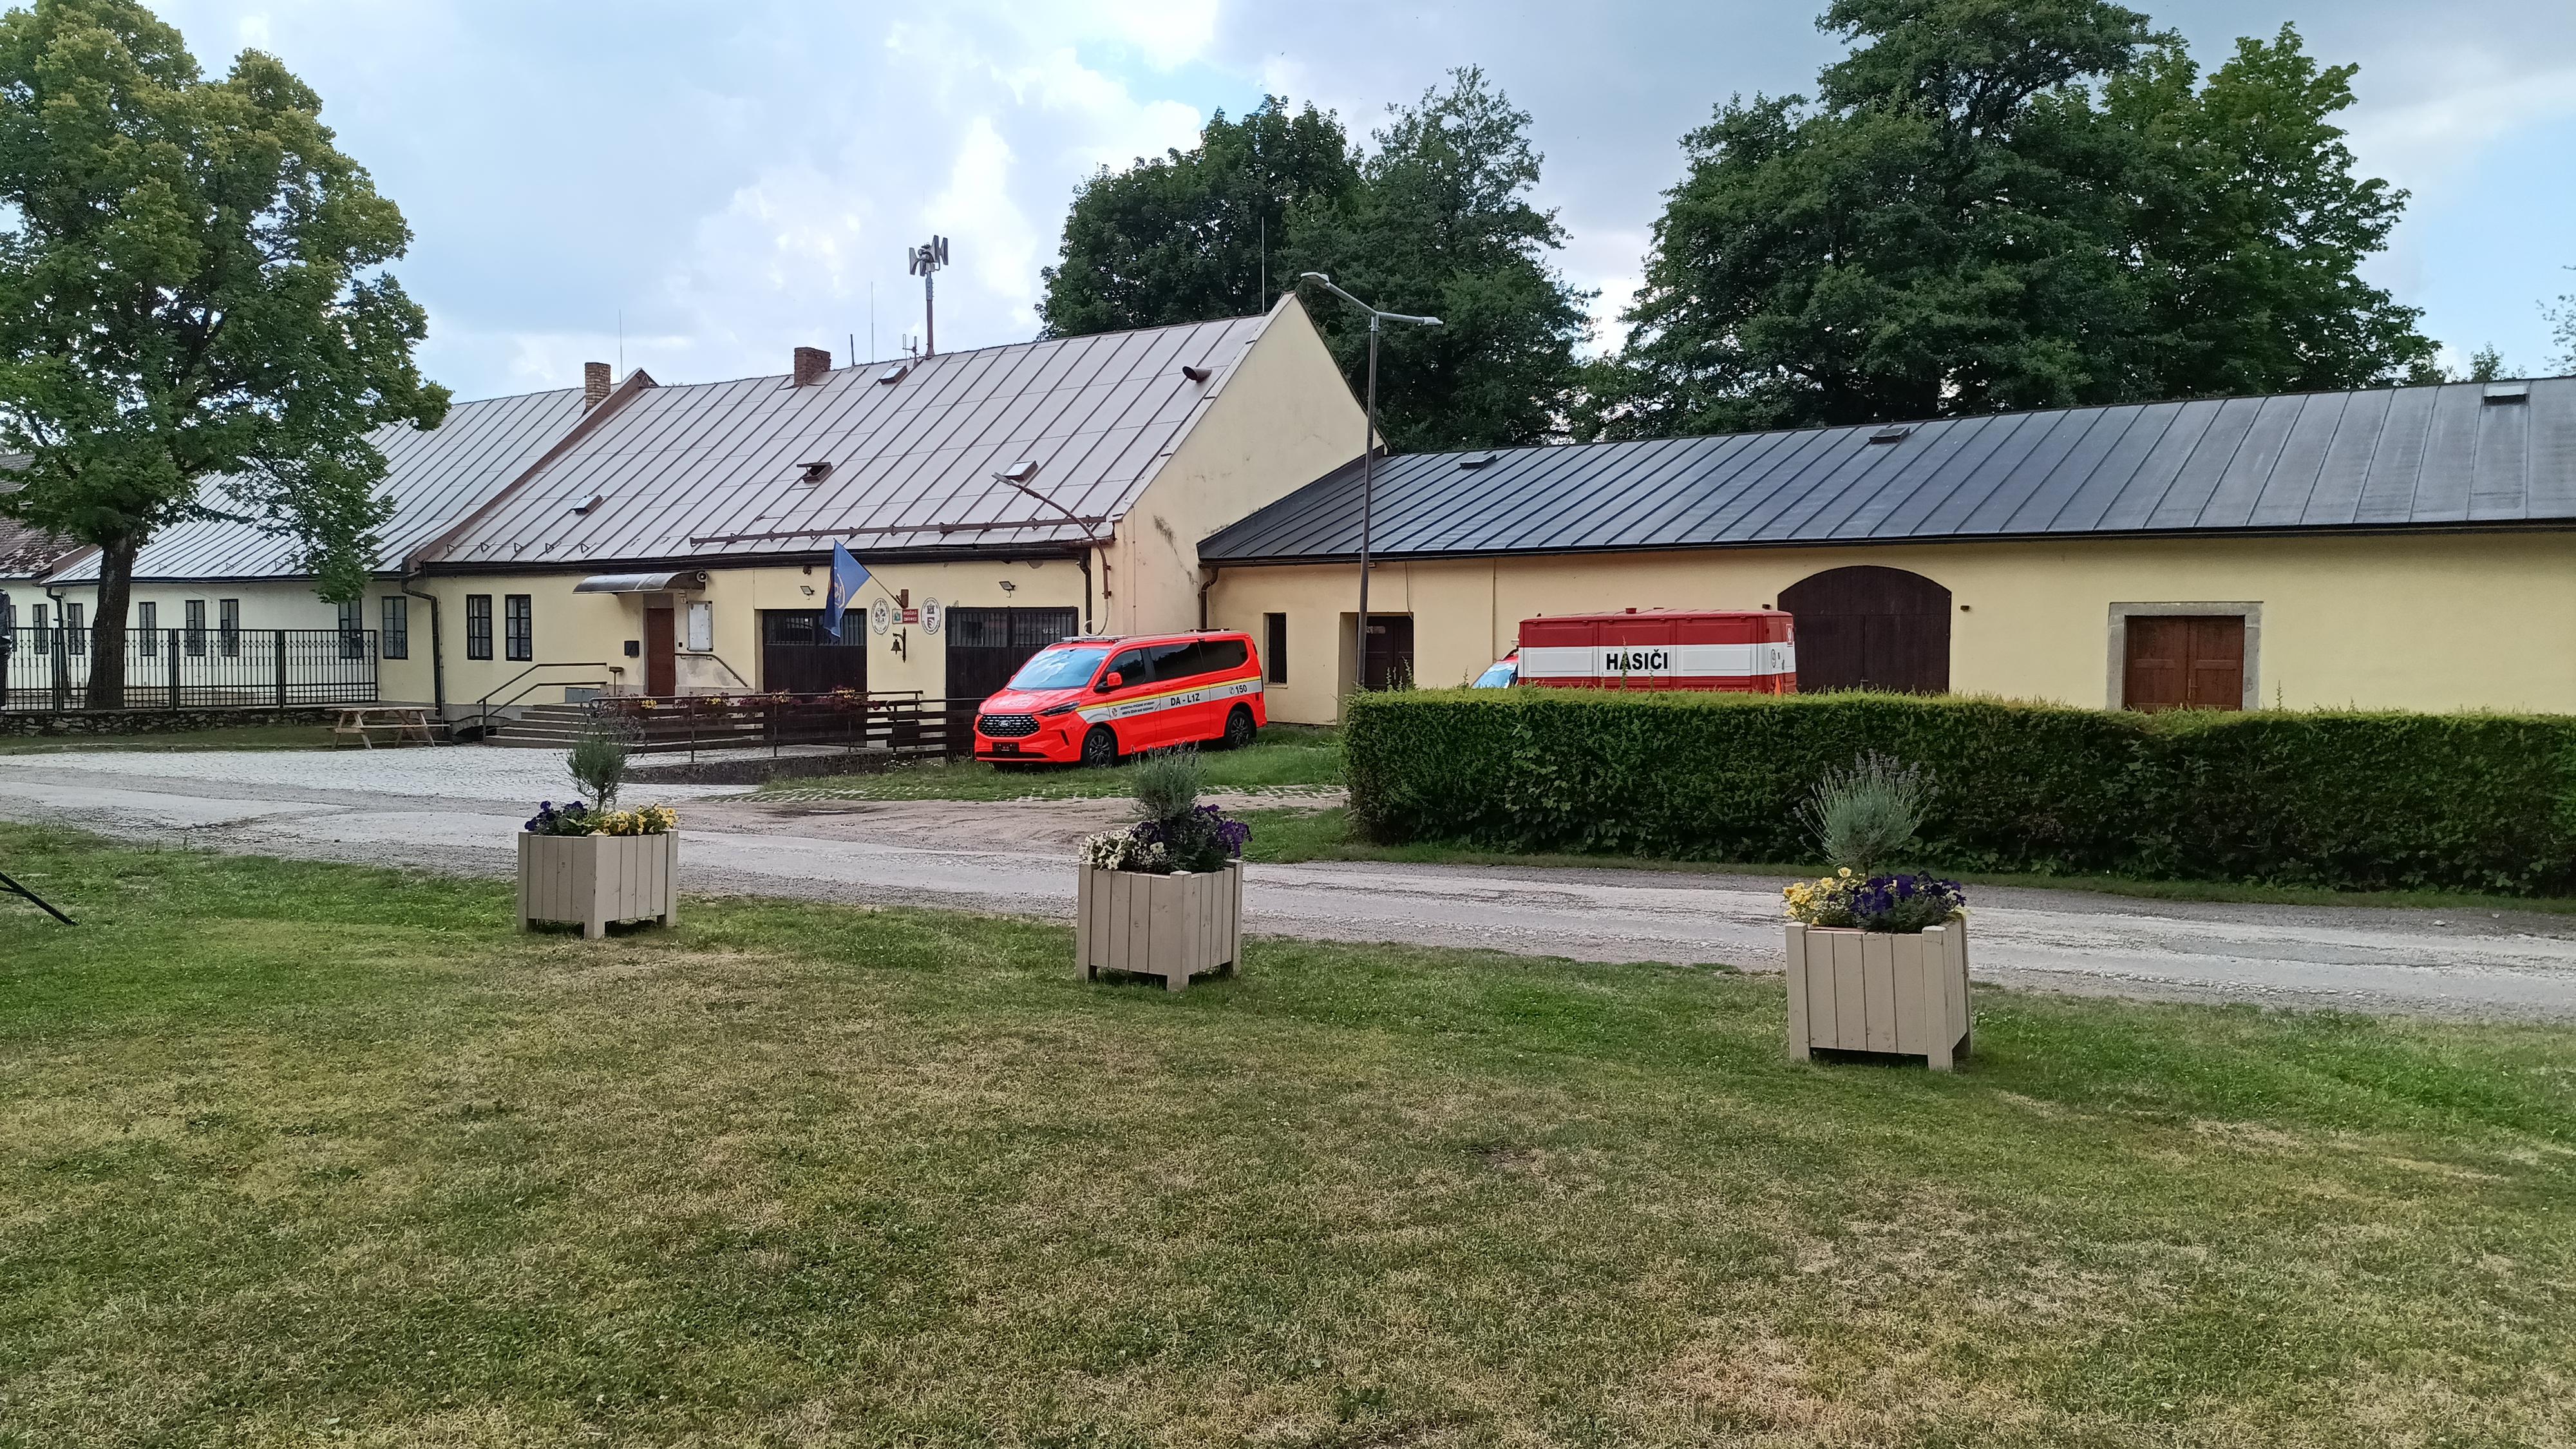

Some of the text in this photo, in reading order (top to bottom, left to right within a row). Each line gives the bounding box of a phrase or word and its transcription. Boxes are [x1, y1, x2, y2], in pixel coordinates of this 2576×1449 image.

[1606, 649, 1668, 670] HASIČI
[1236, 685, 1247, 694] 150
[1170, 697, 1181, 706] DA
[1187, 693, 1200, 703] L1Z
